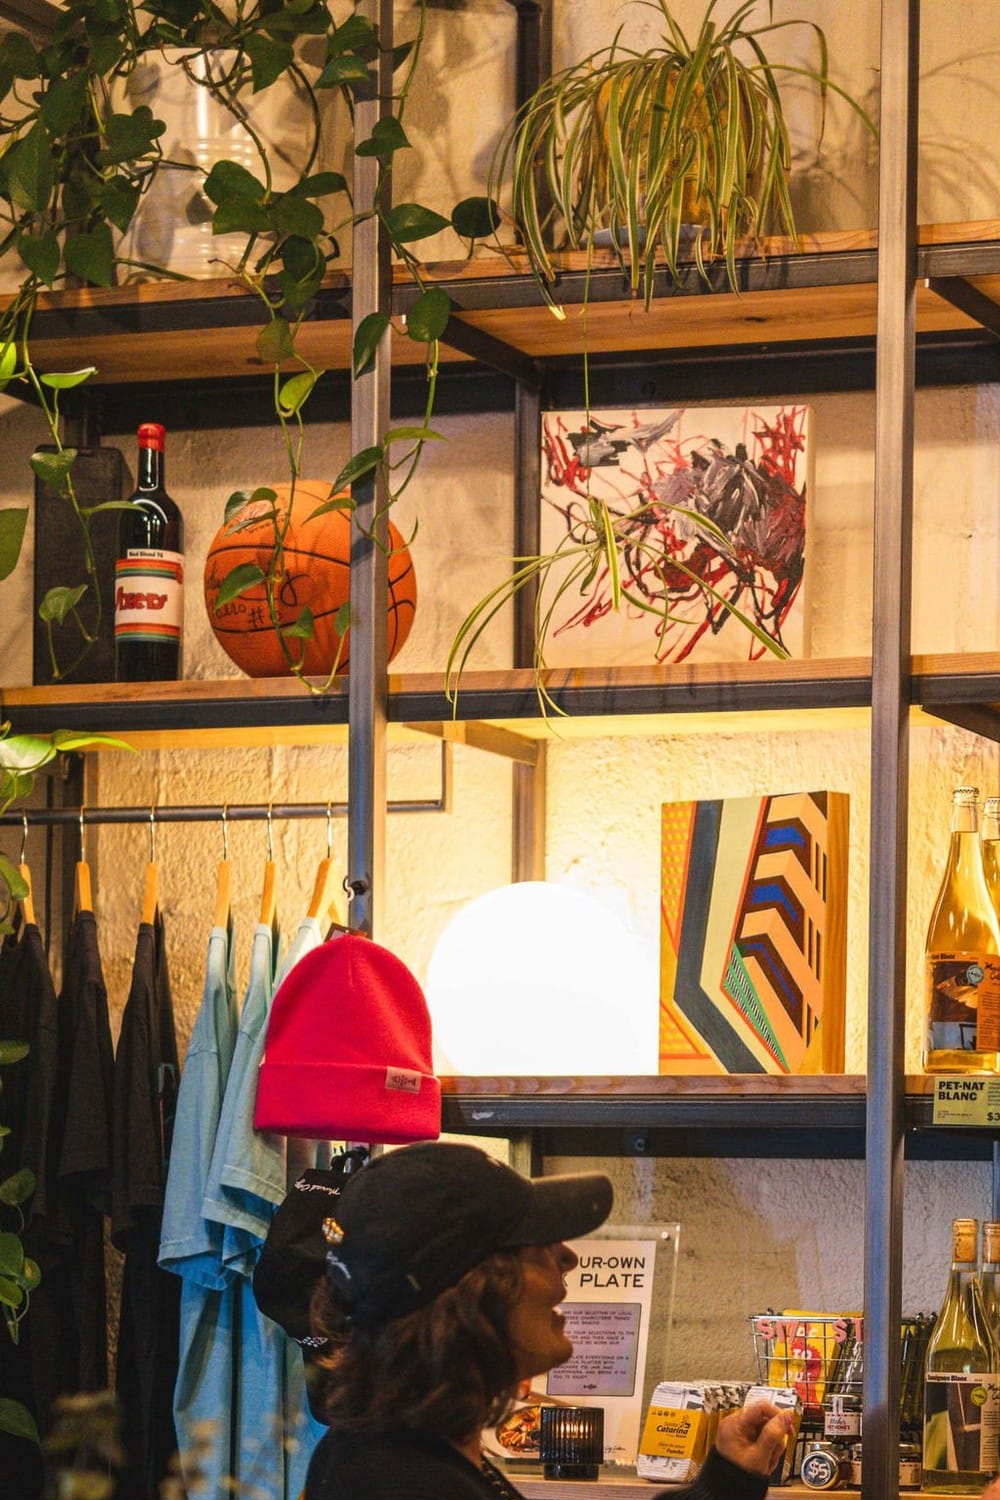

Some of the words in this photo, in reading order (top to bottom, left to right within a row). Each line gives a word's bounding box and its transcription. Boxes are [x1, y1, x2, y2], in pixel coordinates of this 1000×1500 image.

[938, 1081, 985, 1091] PET-NAT
[938, 1092, 977, 1101] BLANC
[580, 1256, 645, 1269] UR-OWN
[580, 1273, 644, 1288] PLATE
[656, 1425, 689, 1436] Catarina
[808, 1459, 829, 1480] $5
